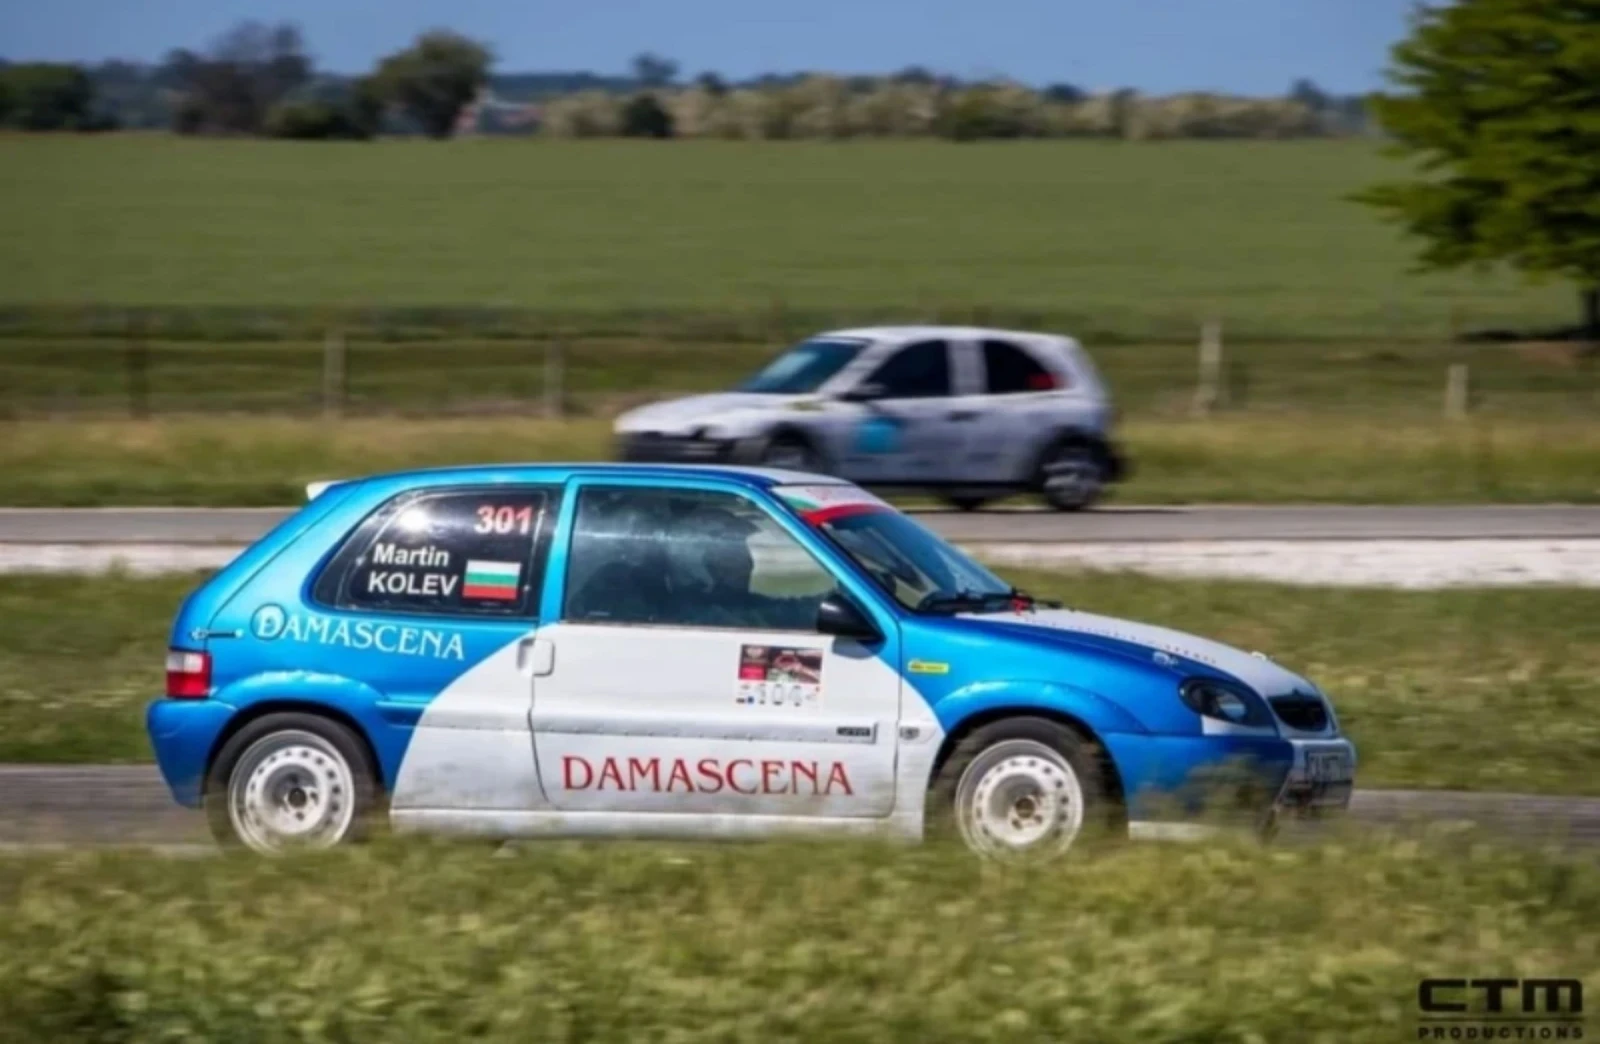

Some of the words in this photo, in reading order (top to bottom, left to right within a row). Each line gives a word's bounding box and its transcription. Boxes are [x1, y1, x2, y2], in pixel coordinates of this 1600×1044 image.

[475, 505, 532, 535] 301
[372, 543, 449, 567] Martin
[367, 571, 458, 597] KOLEV
[254, 604, 465, 661] DAMASCENA
[562, 755, 854, 796] DAMASCENA
